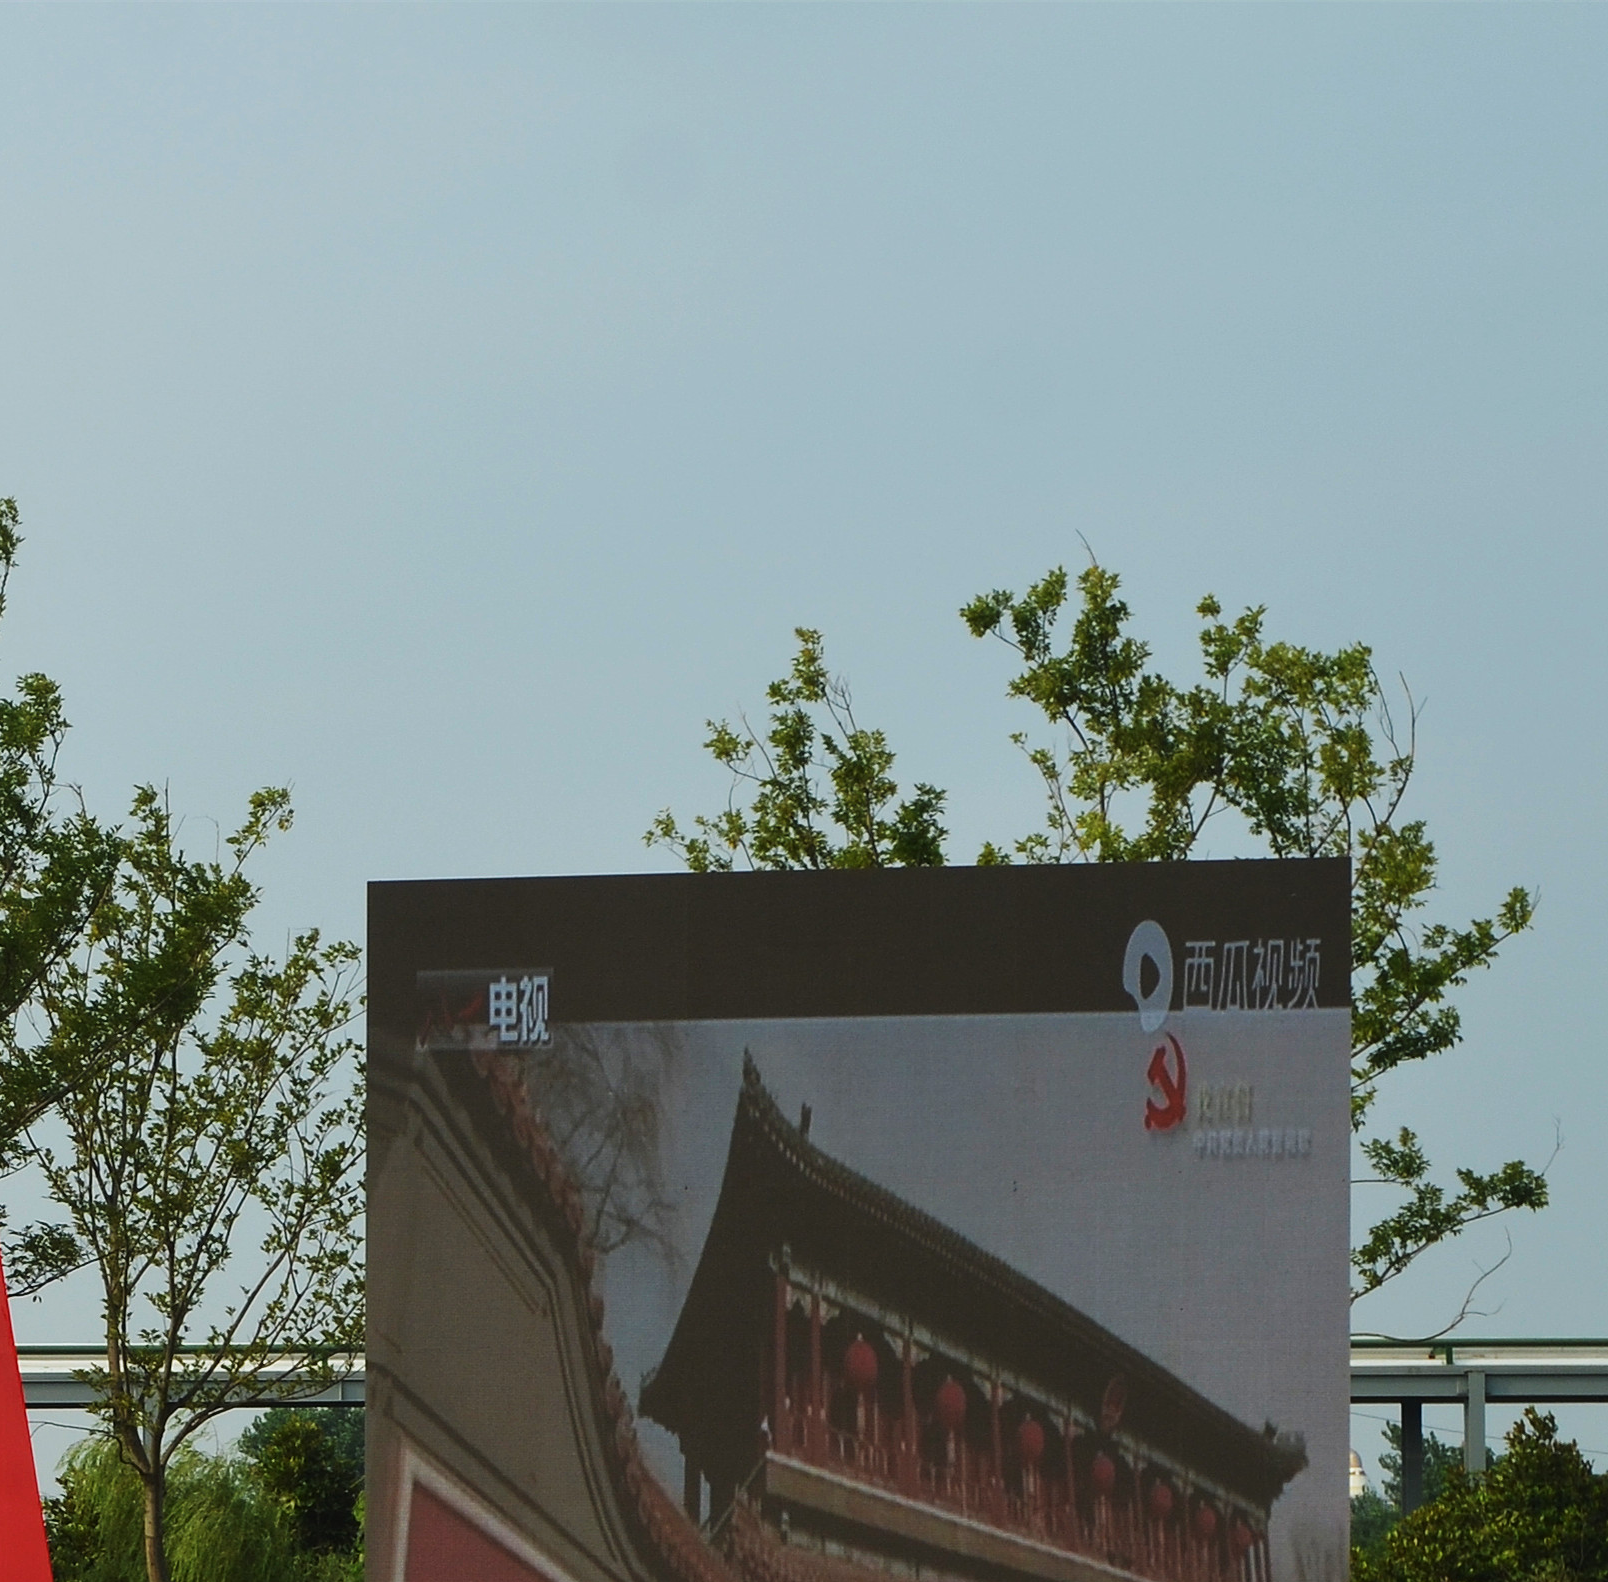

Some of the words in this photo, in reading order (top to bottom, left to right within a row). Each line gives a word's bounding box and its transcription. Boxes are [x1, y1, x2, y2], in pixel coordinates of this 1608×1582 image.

[1184, 939, 1320, 1010] 西瓜视频
[489, 976, 550, 1043] 电视
